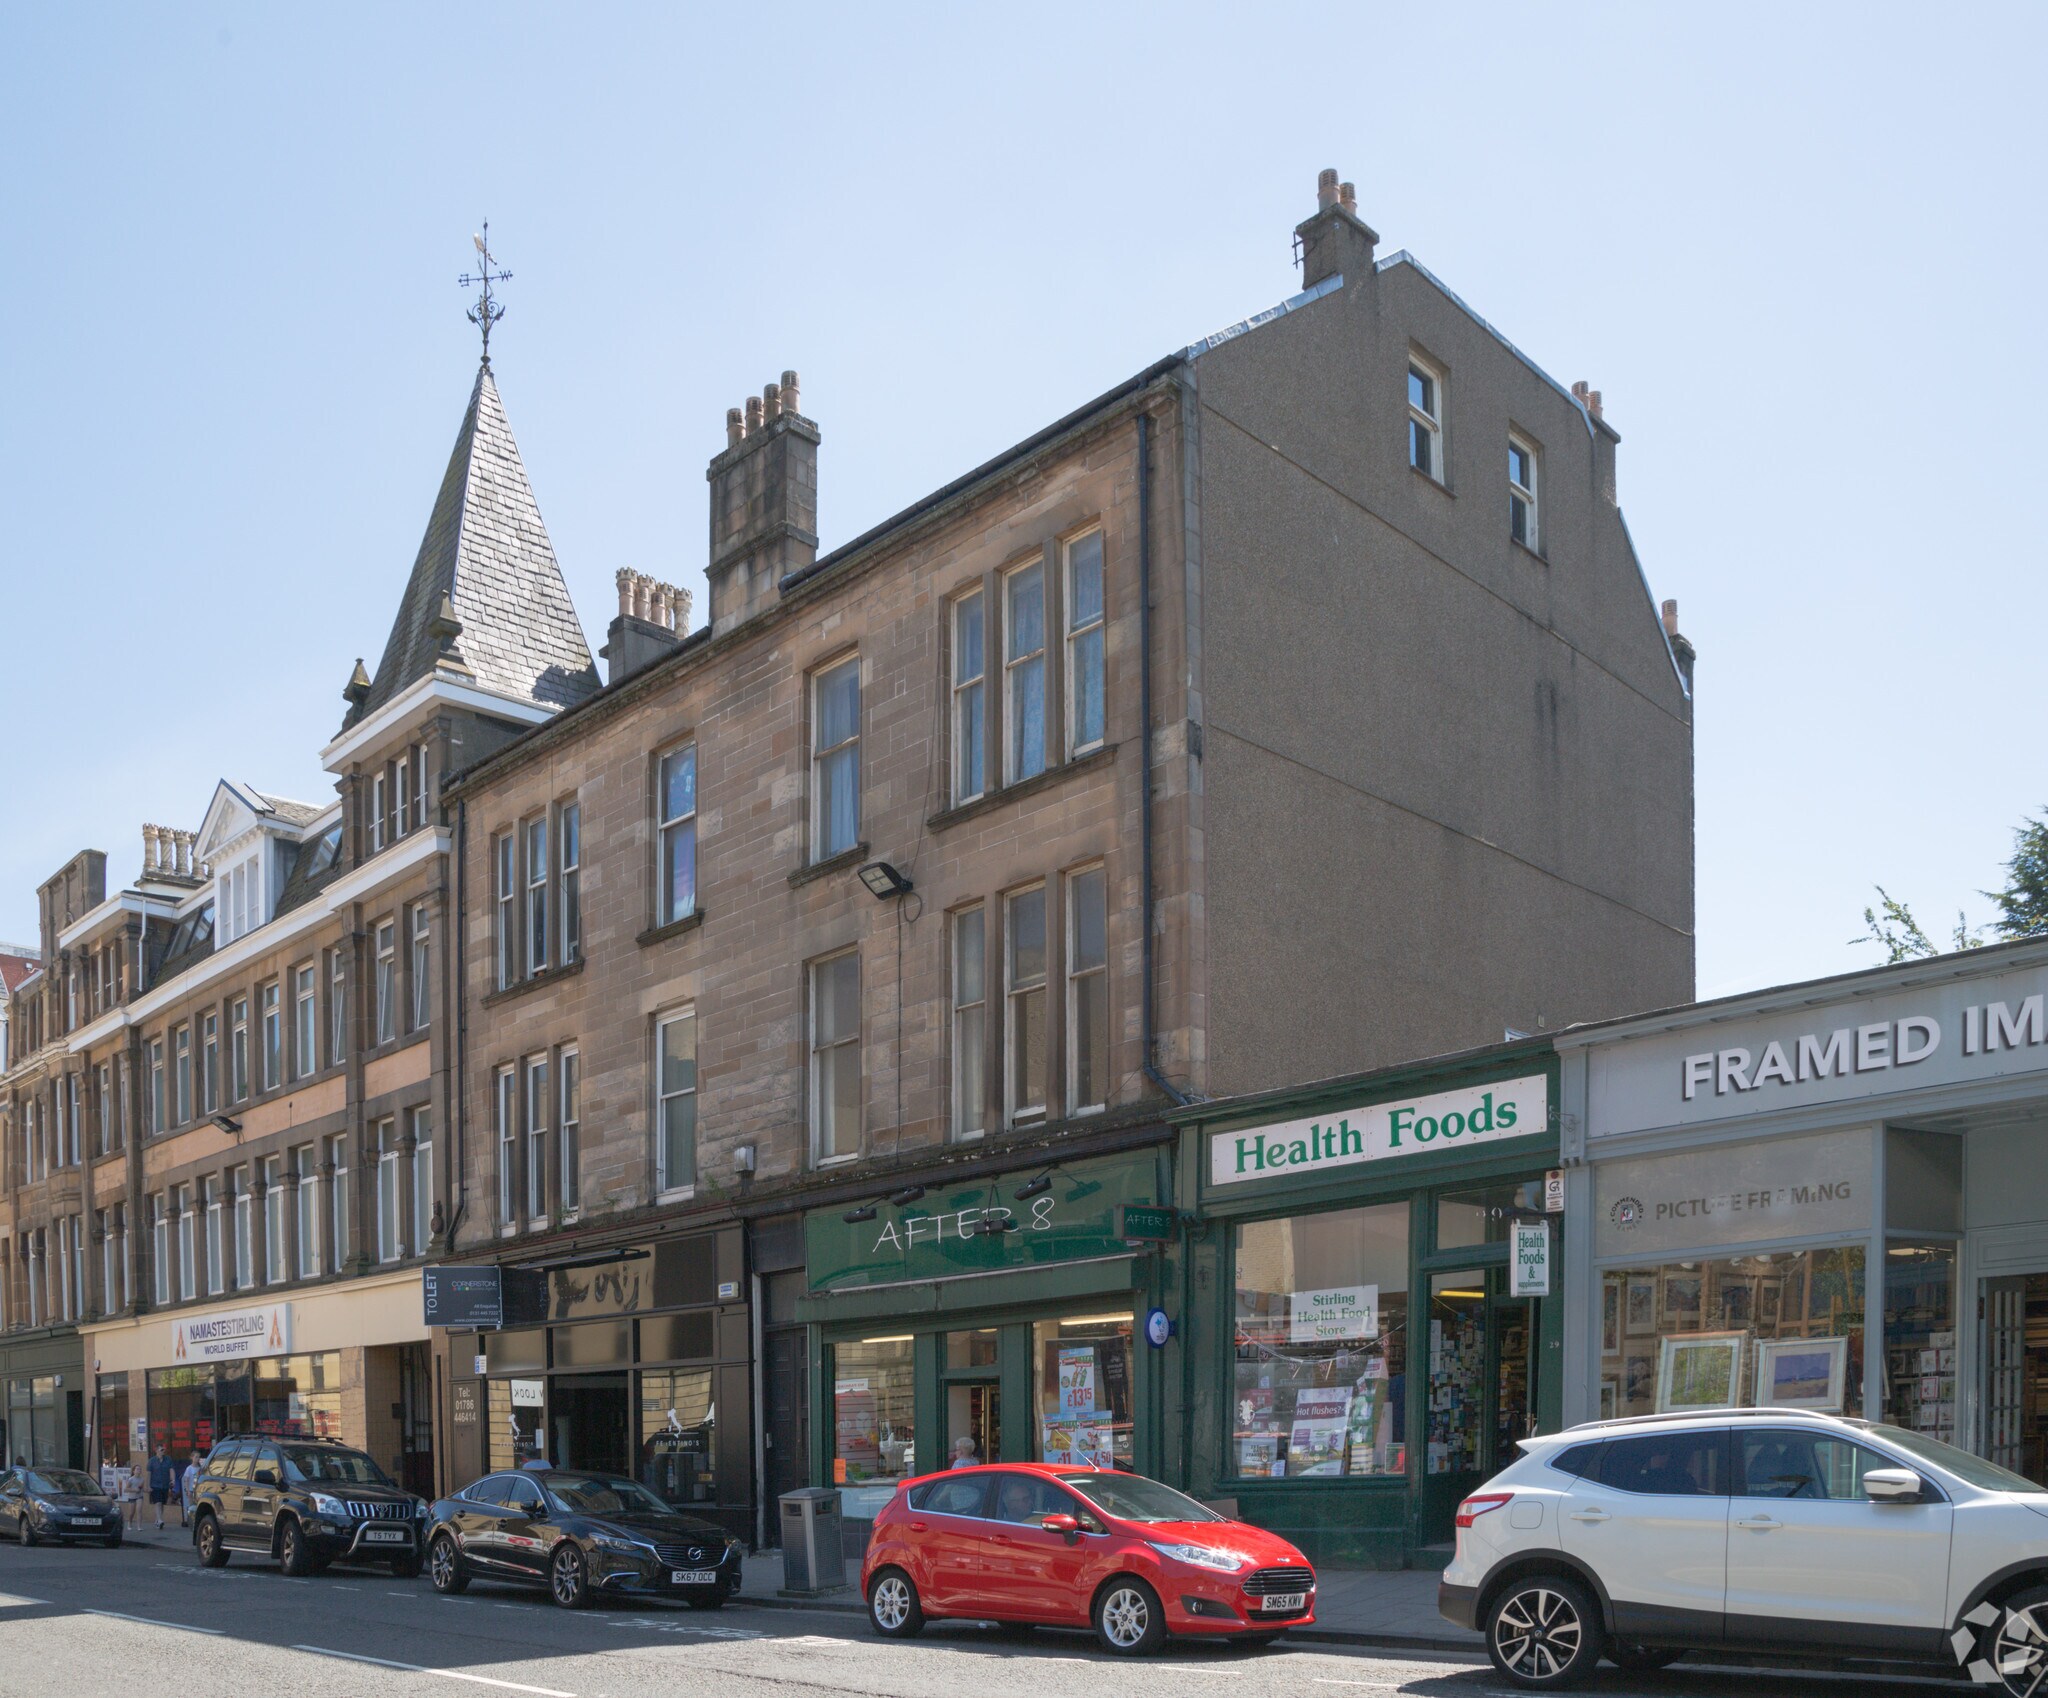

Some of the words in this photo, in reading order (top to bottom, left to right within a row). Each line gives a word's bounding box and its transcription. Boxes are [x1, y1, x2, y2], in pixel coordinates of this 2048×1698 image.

[1682, 1016, 1941, 1100] FRAMED
[1962, 995, 2048, 1053] IM
[1235, 1119, 1363, 1173] Health
[1388, 1093, 1517, 1148] Foods
[1656, 1194, 1742, 1220] PICTUE
[1748, 1181, 1851, 1209] FRMING
[873, 1207, 1020, 1252] AFTER
[1031, 1197, 1055, 1230] 8
[1125, 1213, 1163, 1227] AFTER
[1518, 1232, 1545, 1248] Health
[1518, 1248, 1545, 1265] Foods
[1528, 1265, 1536, 1279] &
[1518, 1280, 1545, 1290] supplements
[1313, 1292, 1356, 1307] Stirling
[1297, 1308, 1337, 1323] Health
[1341, 1305, 1371, 1320] Food
[1315, 1324, 1346, 1336] Store
[204, 1343, 225, 1355] WORLD
[226, 1341, 248, 1353] BUFFET
[1549, 1340, 1560, 1349] 29
[458, 1387, 471, 1398] Tel:
[455, 1399, 475, 1411] 01786
[1296, 1407, 1309, 1416] Hot
[1311, 1405, 1342, 1416] flushes?
[453, 1411, 477, 1422] 446414
[383, 1532, 397, 1540] TYX
[676, 1572, 697, 1582] SK67
[698, 1572, 713, 1582] OCC
[1266, 1596, 1287, 1609] SM65
